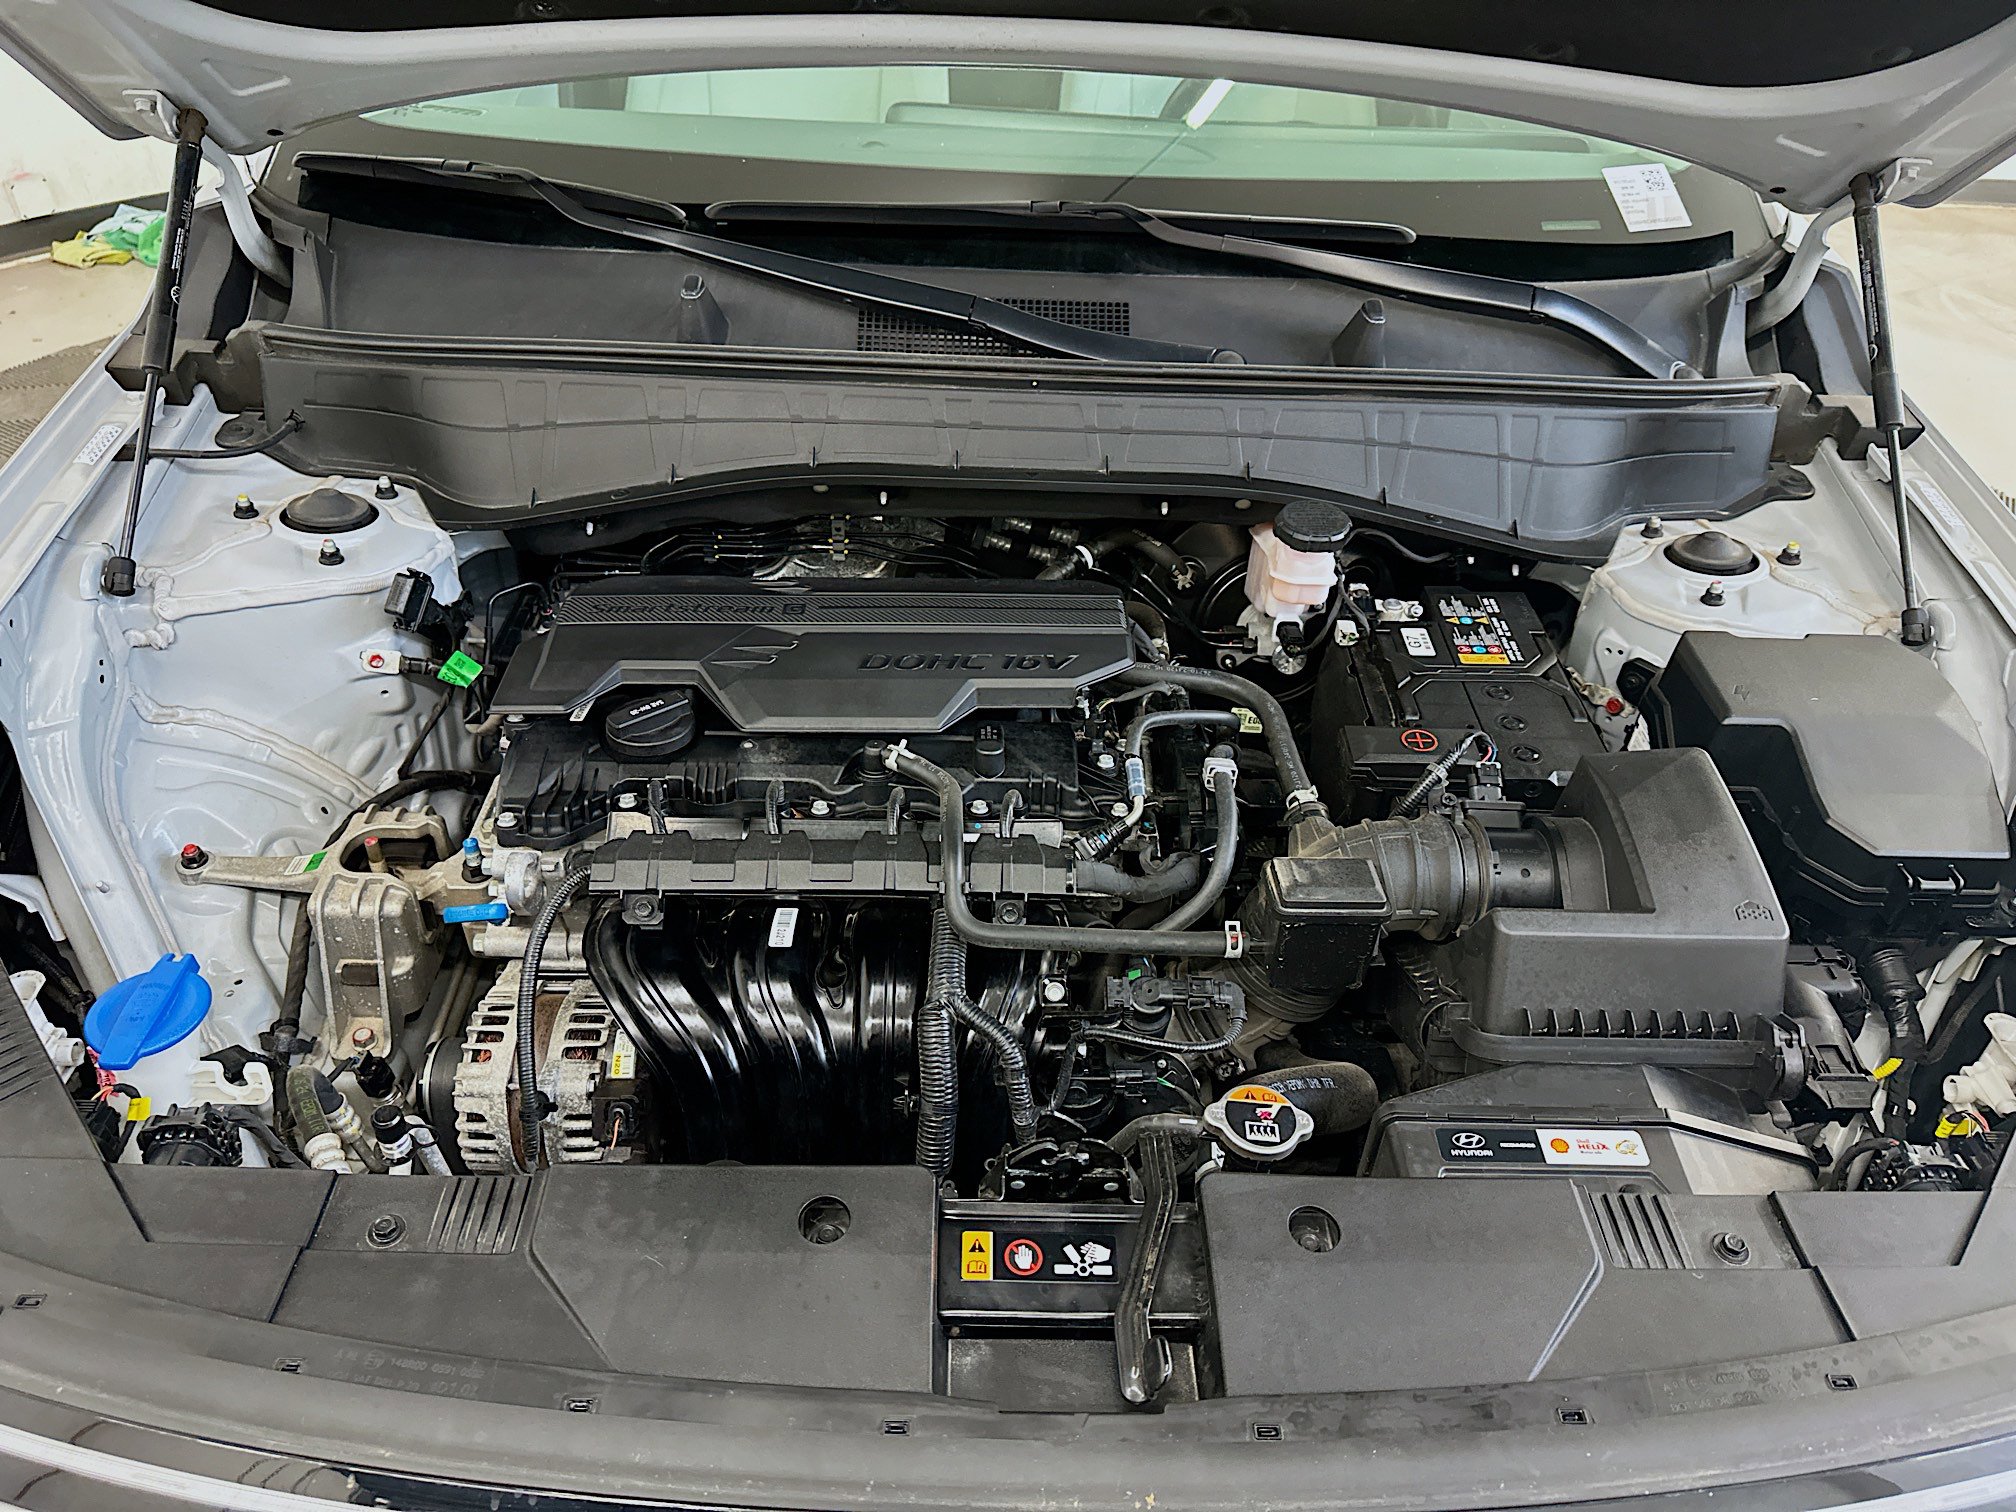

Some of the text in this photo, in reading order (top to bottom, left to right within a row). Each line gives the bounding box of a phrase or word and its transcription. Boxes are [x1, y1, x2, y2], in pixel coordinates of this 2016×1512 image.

[1406, 635, 1422, 648] G7
[857, 653, 1080, 671] DOHC 16V
[1578, 1142, 1611, 1151] HELIX
[1450, 1149, 1494, 1158] HYUNDAI
